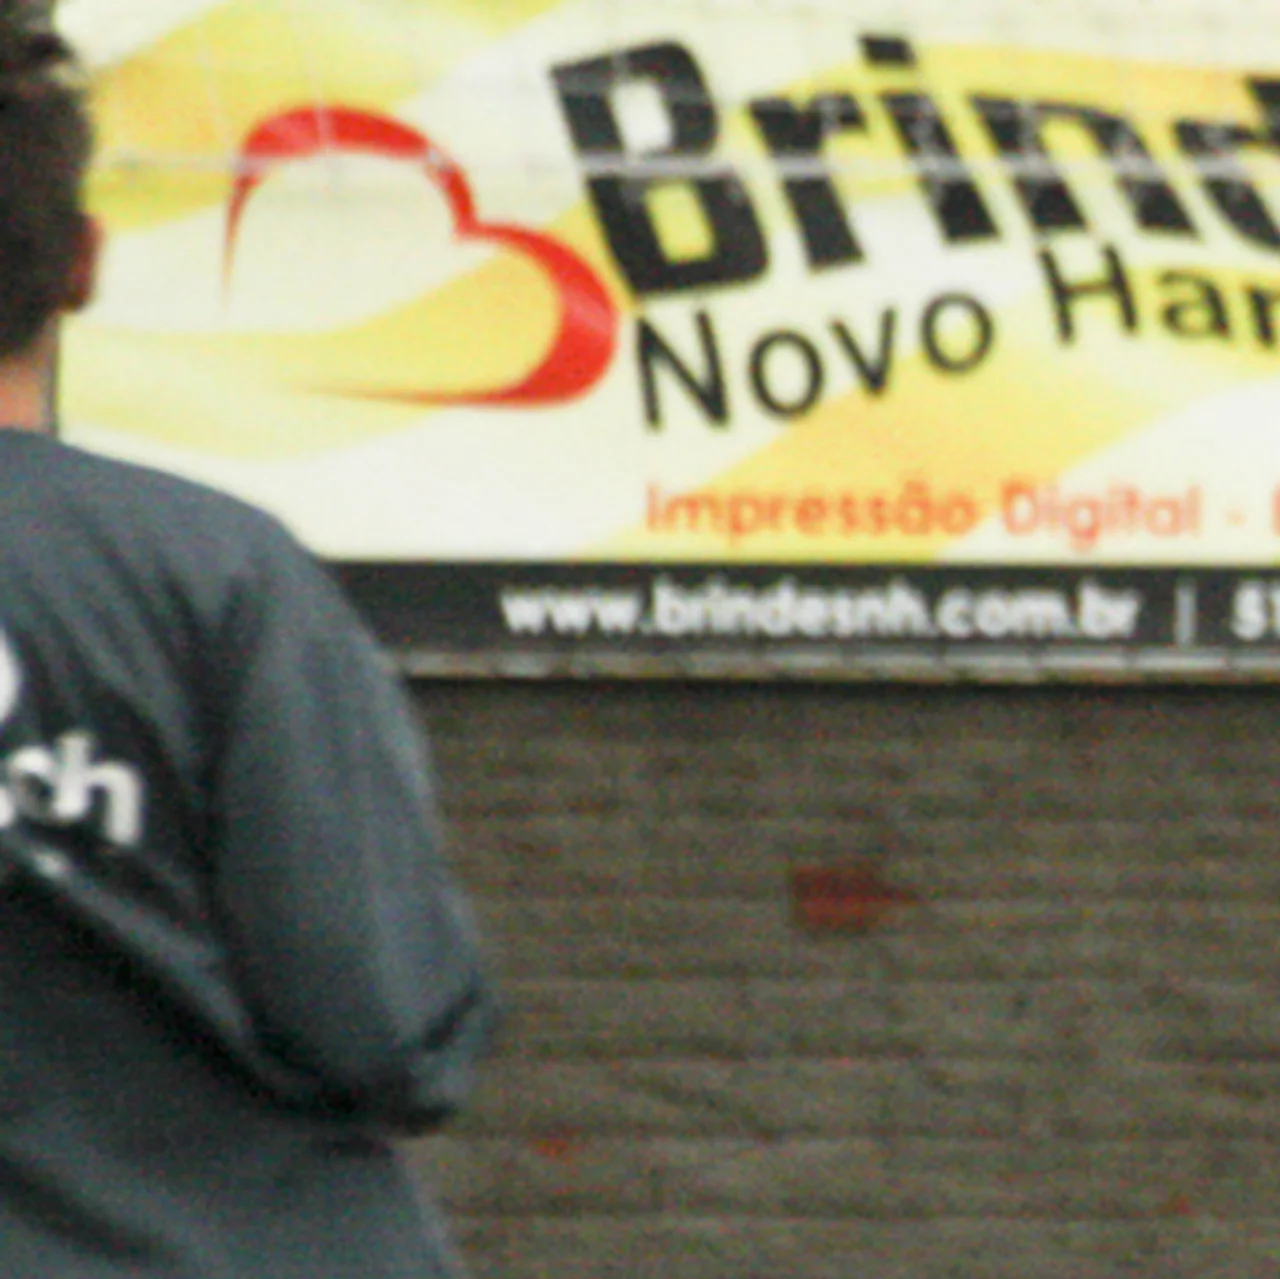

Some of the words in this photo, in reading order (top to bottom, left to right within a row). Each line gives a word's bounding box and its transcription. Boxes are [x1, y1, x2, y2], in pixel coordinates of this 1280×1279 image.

[634, 292, 996, 432] Novo
[1000, 480, 1200, 552] Digital
[500, 576, 1140, 638] www.brindesnh.com.br
